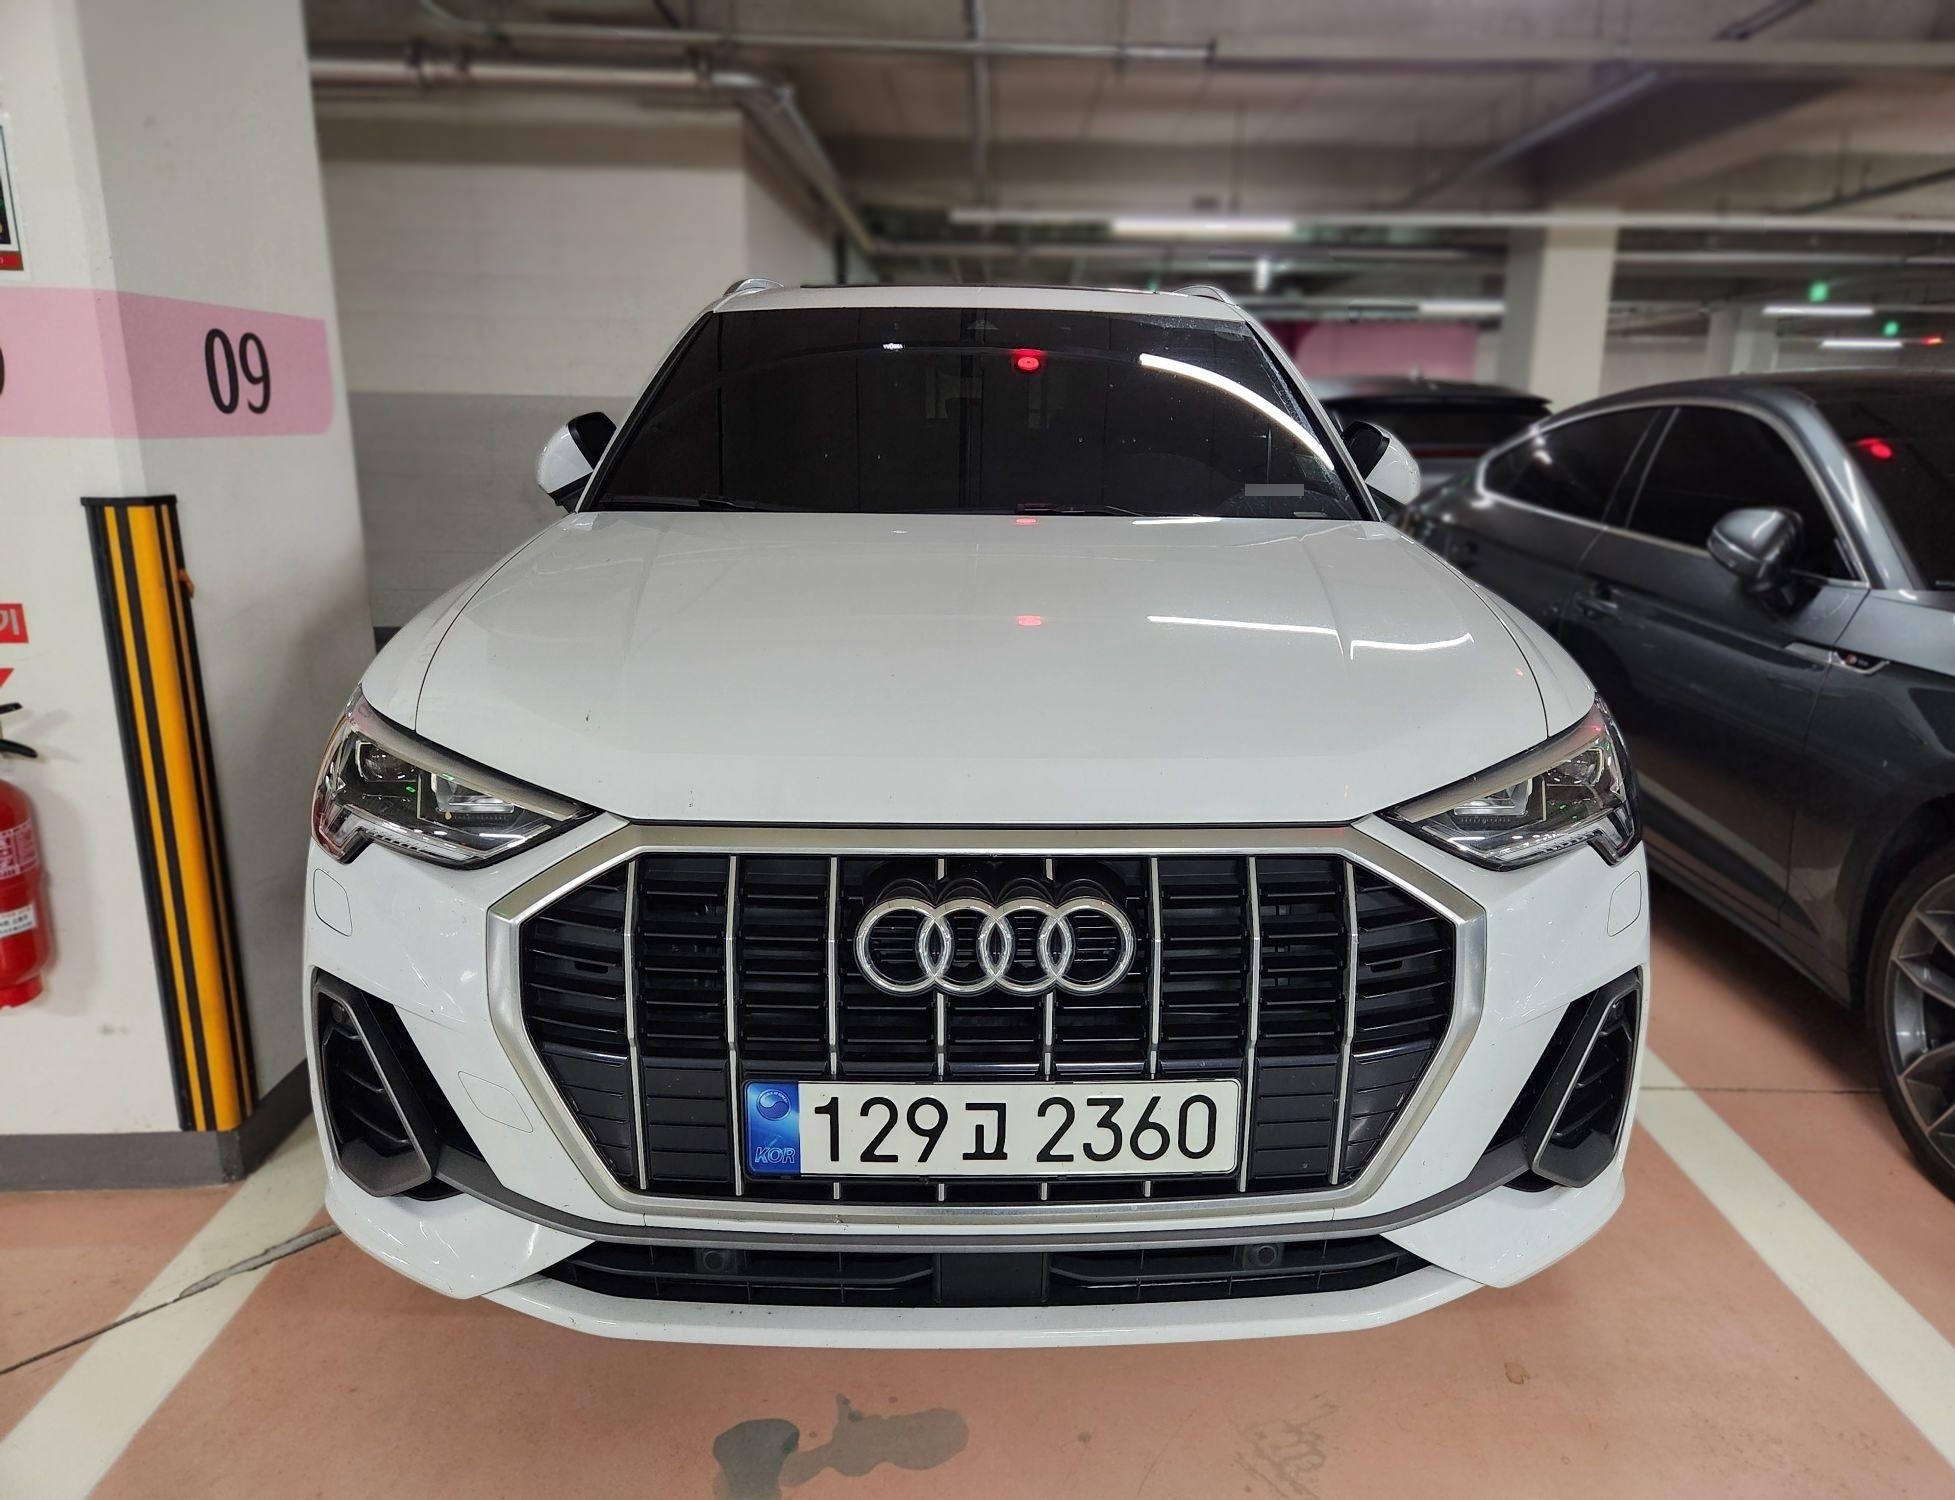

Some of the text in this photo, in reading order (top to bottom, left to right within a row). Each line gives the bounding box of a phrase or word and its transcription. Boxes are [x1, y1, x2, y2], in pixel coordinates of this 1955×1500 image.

[204, 328, 271, 415] 09
[755, 1147, 796, 1163] KOR
[814, 1094, 1218, 1163] 129고 2360
